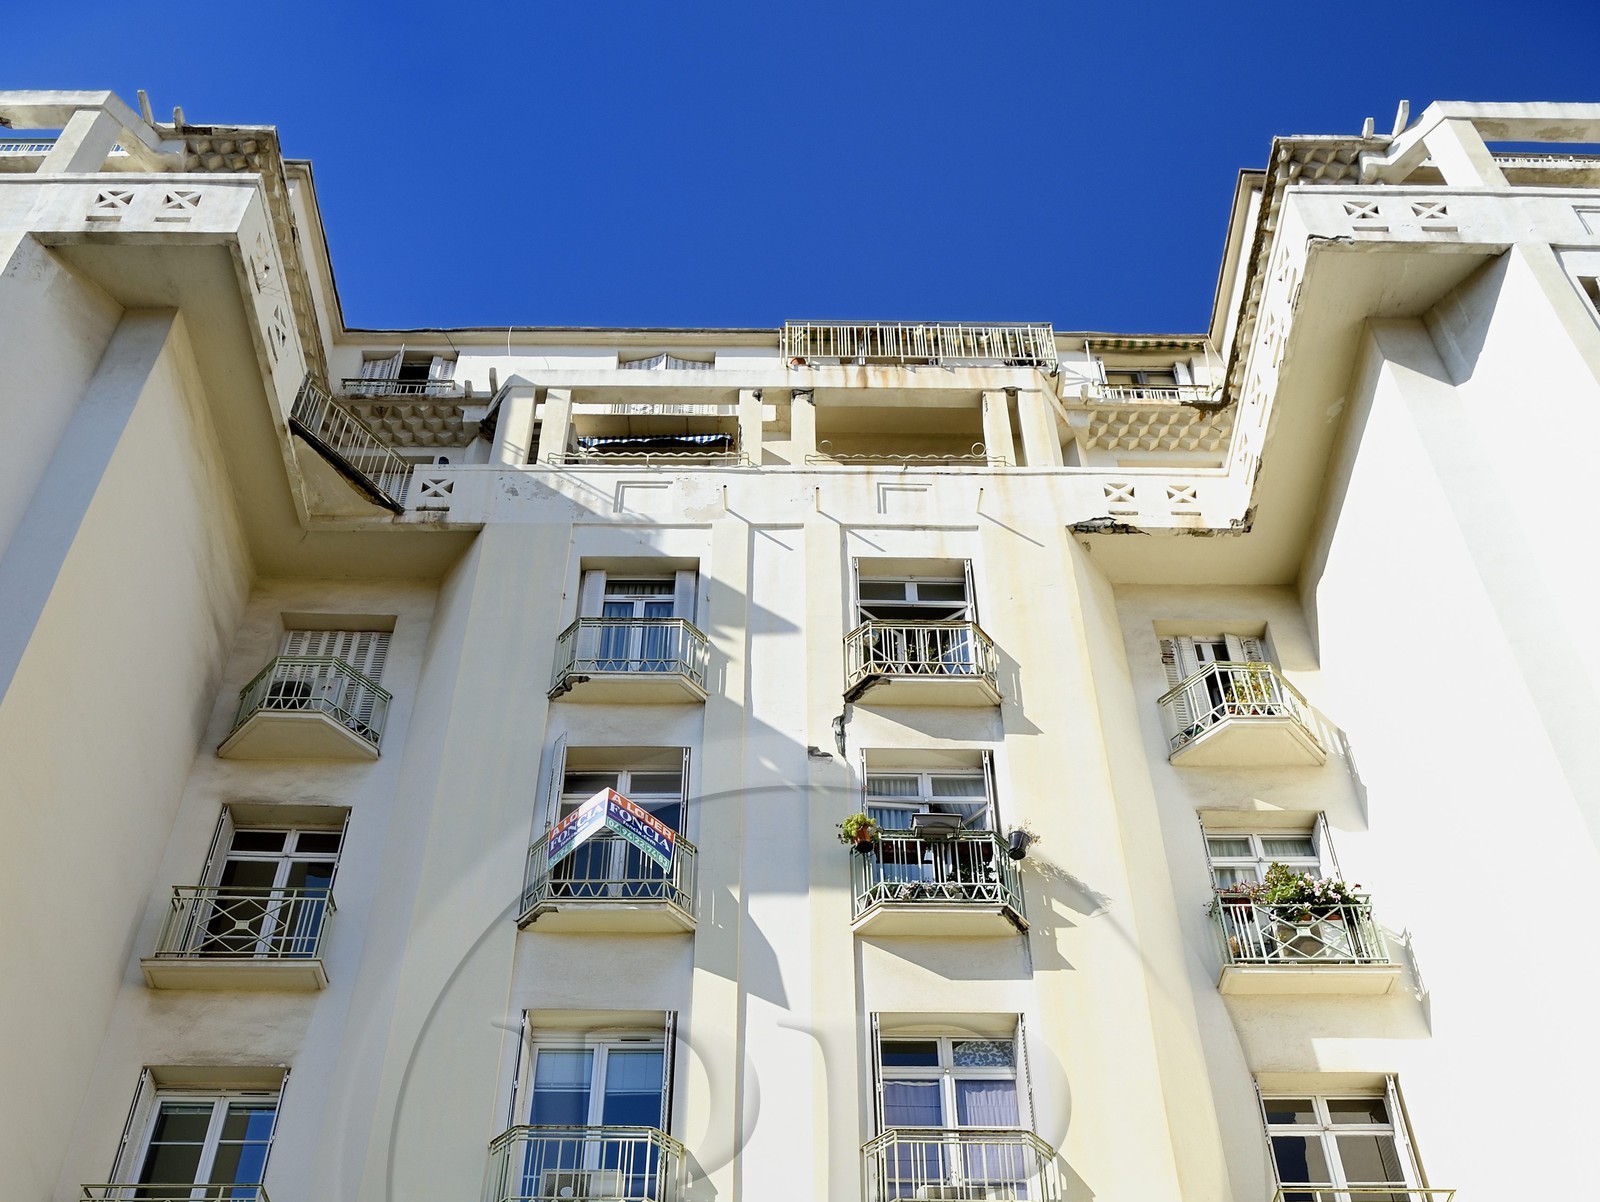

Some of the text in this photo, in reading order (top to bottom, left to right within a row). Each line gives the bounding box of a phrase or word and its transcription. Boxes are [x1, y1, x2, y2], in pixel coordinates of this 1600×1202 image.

[550, 804, 603, 851] FONCIA
[609, 802, 671, 853] FONCIA
[611, 794, 672, 840] A LOUER
